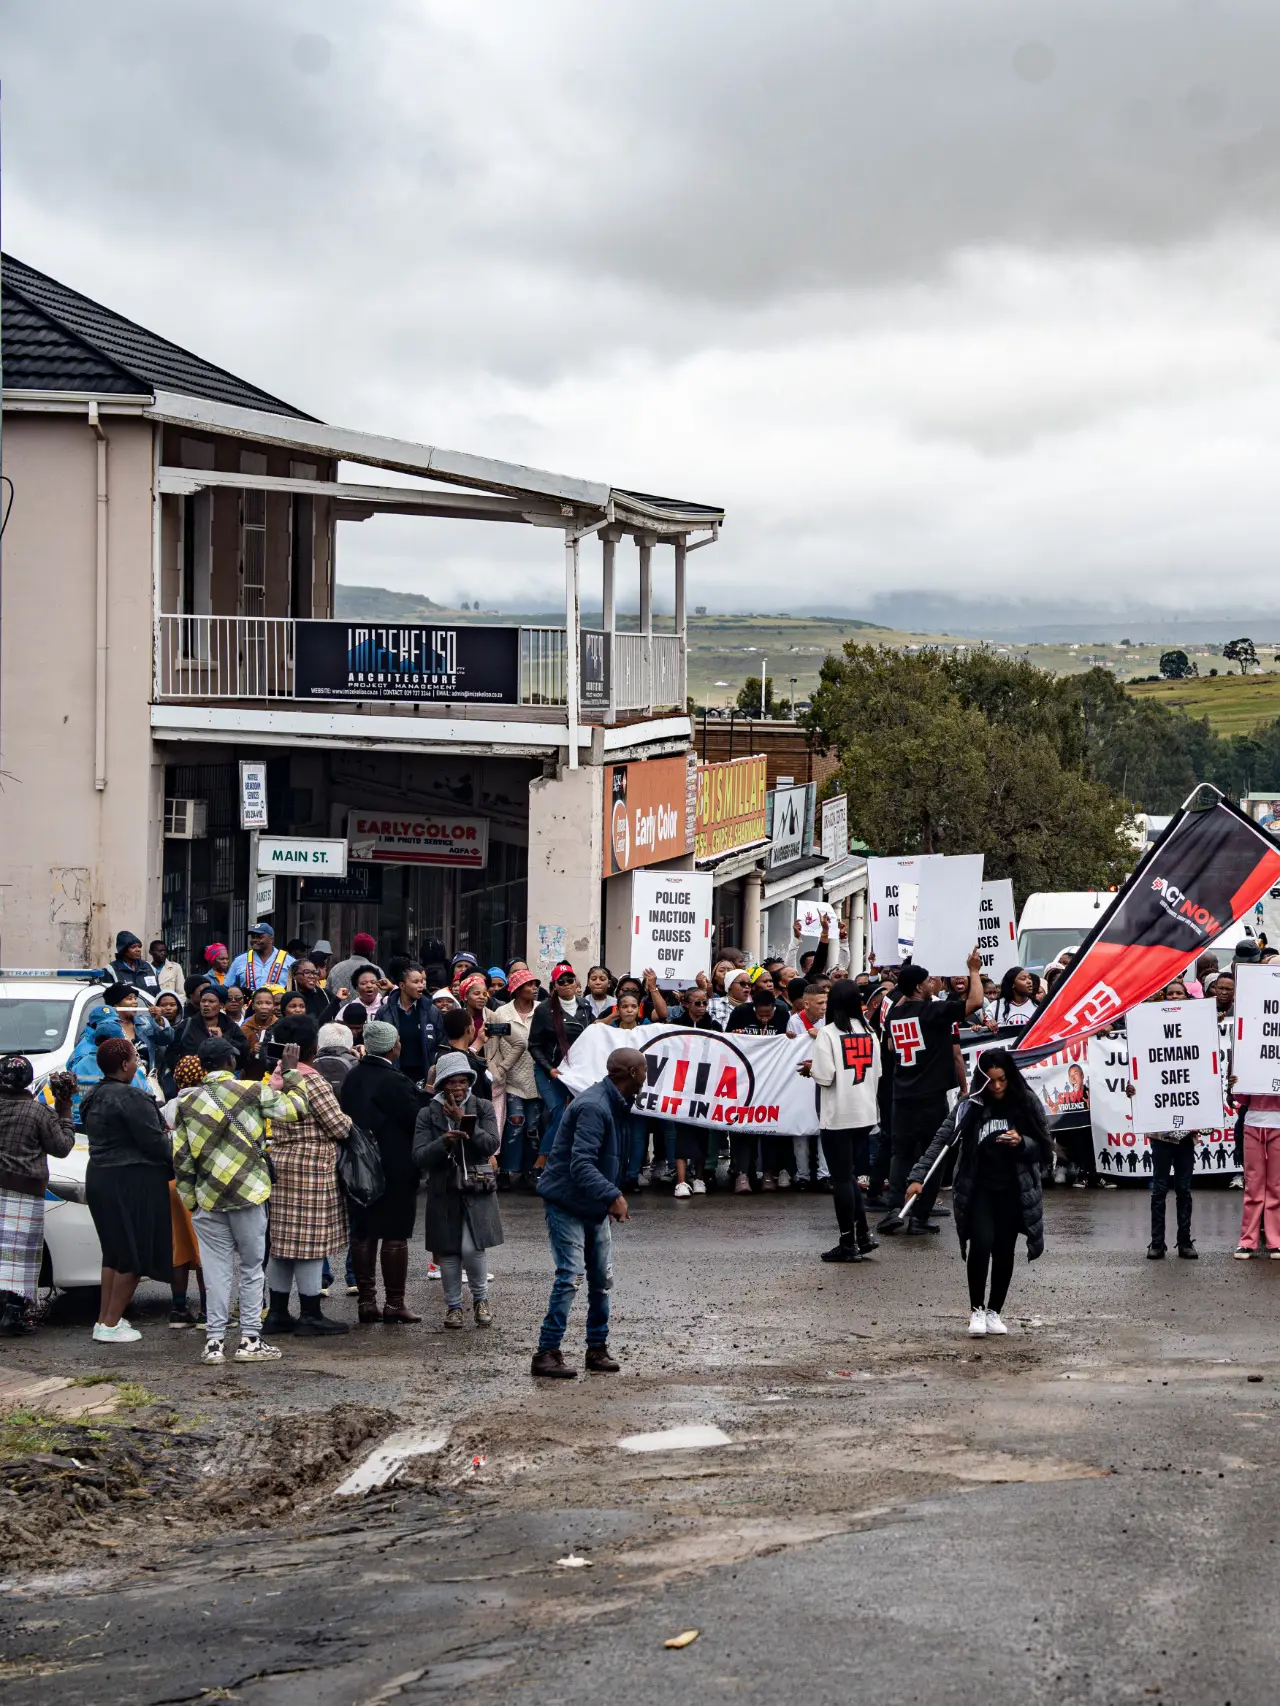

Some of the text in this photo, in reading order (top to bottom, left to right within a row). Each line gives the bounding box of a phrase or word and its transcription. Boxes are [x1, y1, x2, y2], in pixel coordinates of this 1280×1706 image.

[348, 672, 456, 684] ARCHITECTURE
[703, 760, 766, 826] BISMILLAH
[357, 820, 477, 840] EARLYCOLOR
[636, 802, 678, 852] Early Color
[424, 838, 454, 846] SERVICE
[272, 849, 328, 863] MAIN ST.
[656, 891, 690, 904] POLICE
[886, 885, 899, 898] AC
[649, 910, 695, 924] INACTION
[979, 917, 1000, 930] TION
[1180, 900, 1222, 936] NOW
[652, 929, 691, 942] CAUSES
[977, 936, 999, 949] USES
[658, 948, 684, 961] GBVF
[1264, 1000, 1279, 1014] NO
[1163, 1023, 1182, 1038] WE
[1148, 1045, 1200, 1063] DEMAND
[1161, 1069, 1190, 1085] SAFE
[1058, 1091, 1084, 1103] STOP
[1154, 1091, 1200, 1108] SPACES
[661, 1096, 780, 1126] IT IN ACTION
[1058, 1102, 1085, 1111] VIOLENCE
[1107, 1132, 1136, 1146] NO
